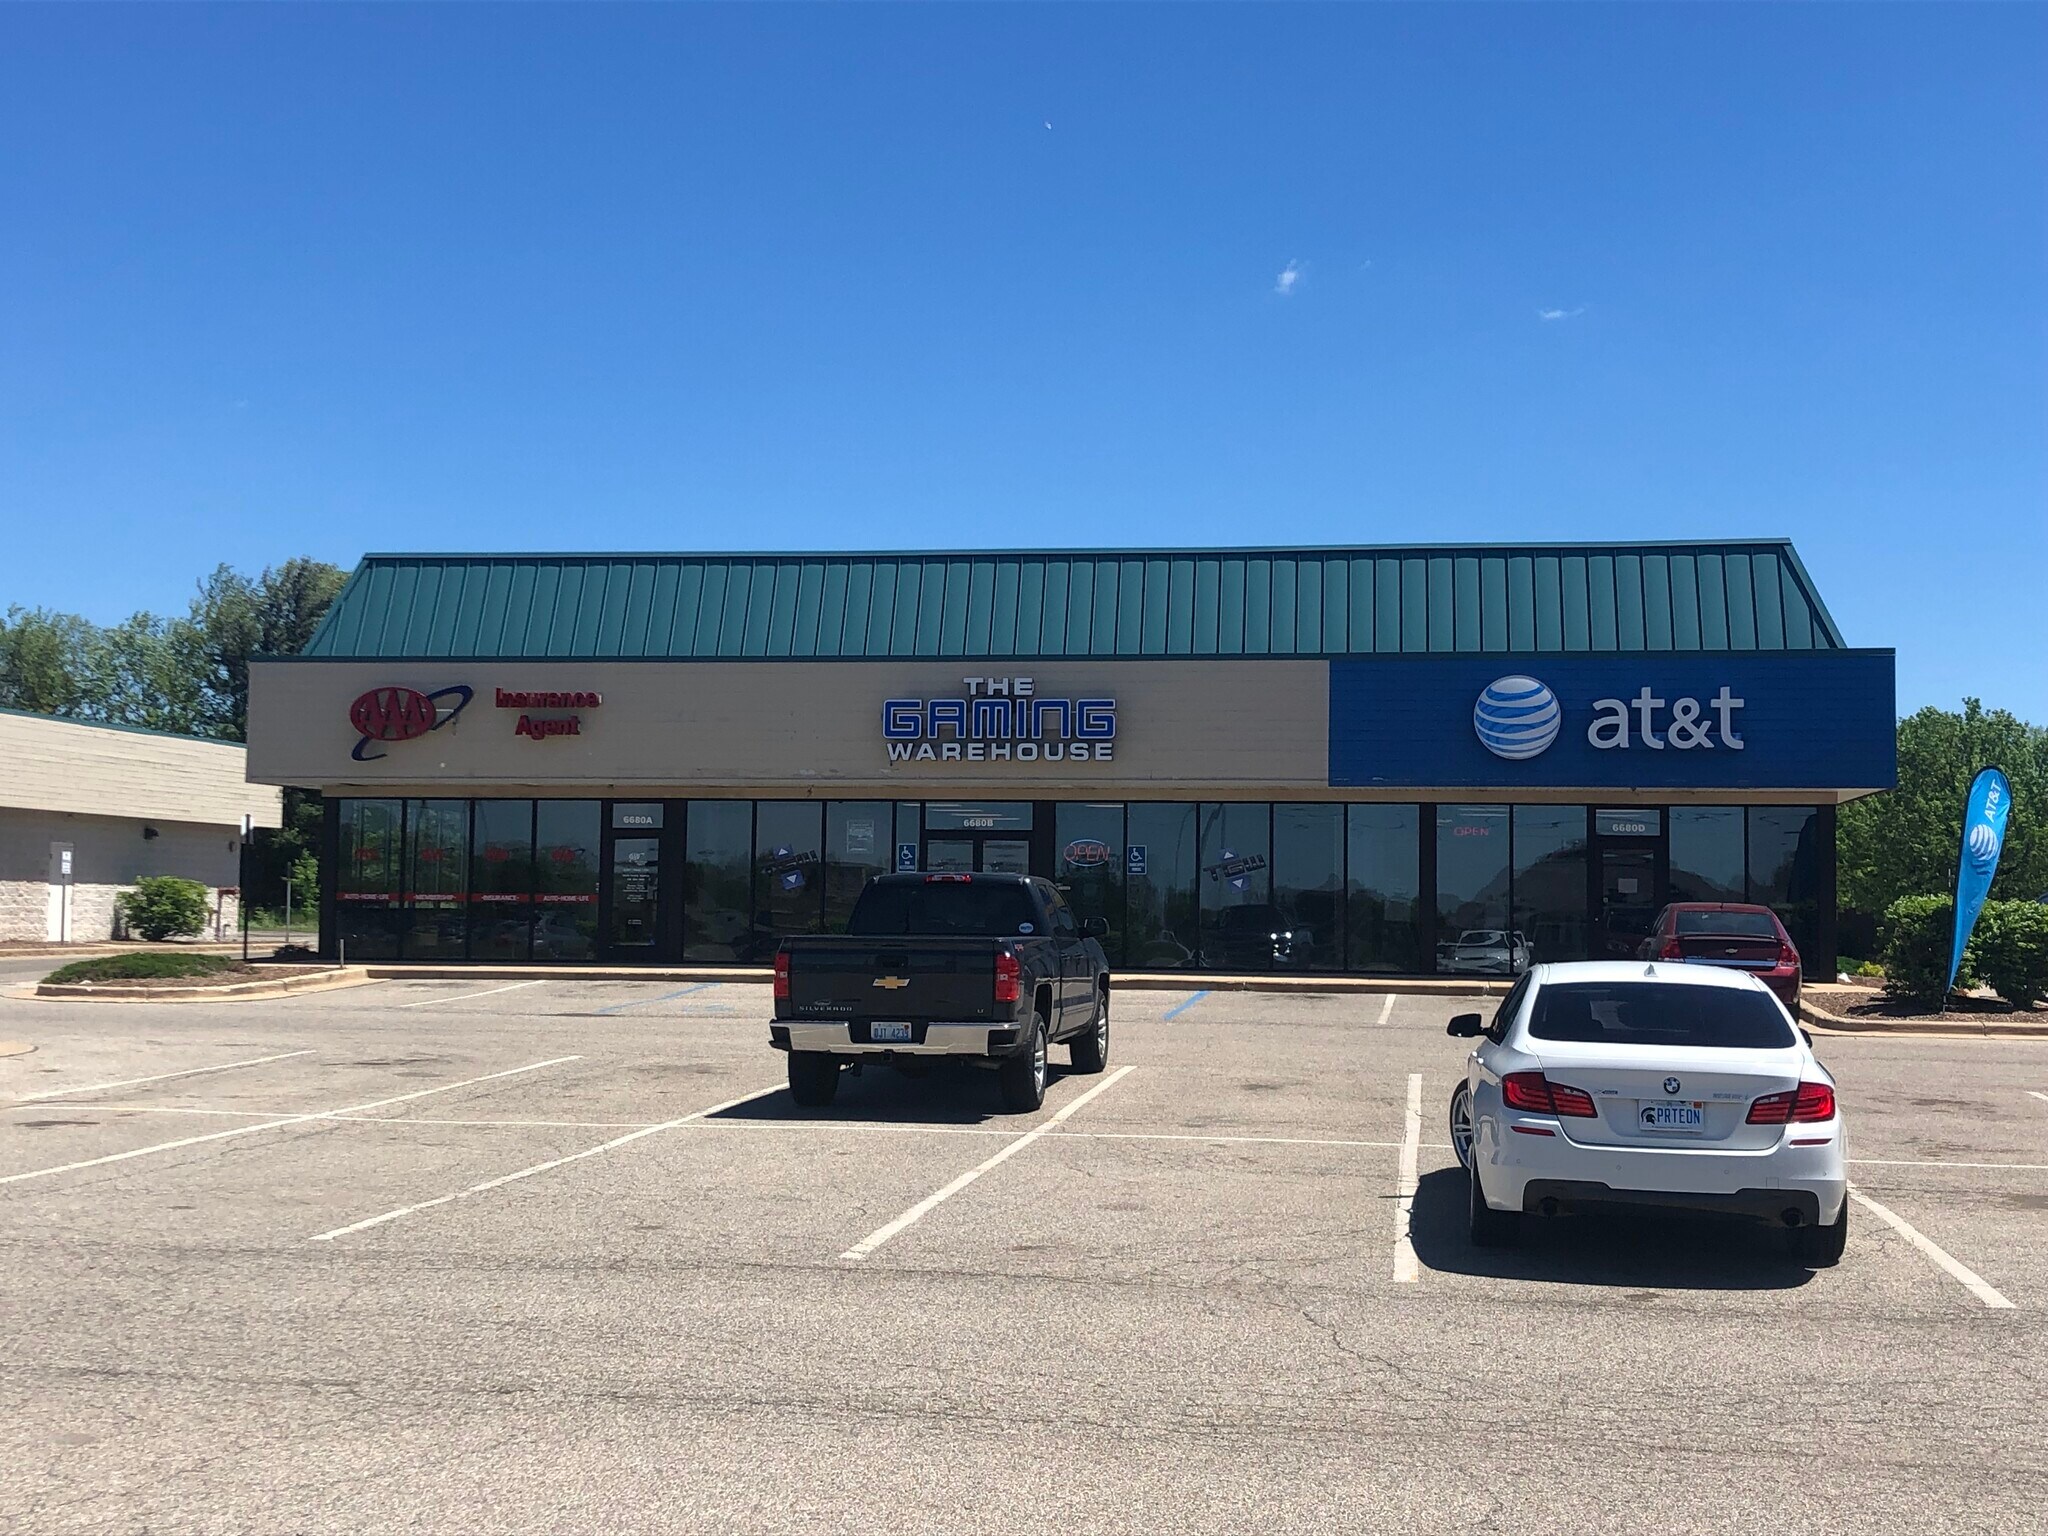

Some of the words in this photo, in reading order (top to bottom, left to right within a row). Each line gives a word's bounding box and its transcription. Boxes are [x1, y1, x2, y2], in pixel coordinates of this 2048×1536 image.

[963, 677, 1035, 696] THE
[496, 687, 600, 708] Insurance
[351, 687, 436, 740] AAA
[882, 699, 1116, 739] GAMING
[1587, 686, 1745, 750] at&t
[515, 715, 580, 740] Agent
[887, 743, 1113, 761] WAREHOUSE
[1984, 778, 2001, 823] AT&T
[623, 816, 653, 825] 6680A
[963, 819, 994, 828] 6680B
[1612, 823, 1646, 833] 6680D
[1453, 826, 1490, 837] OPEN
[1064, 843, 1110, 862] OPEN
